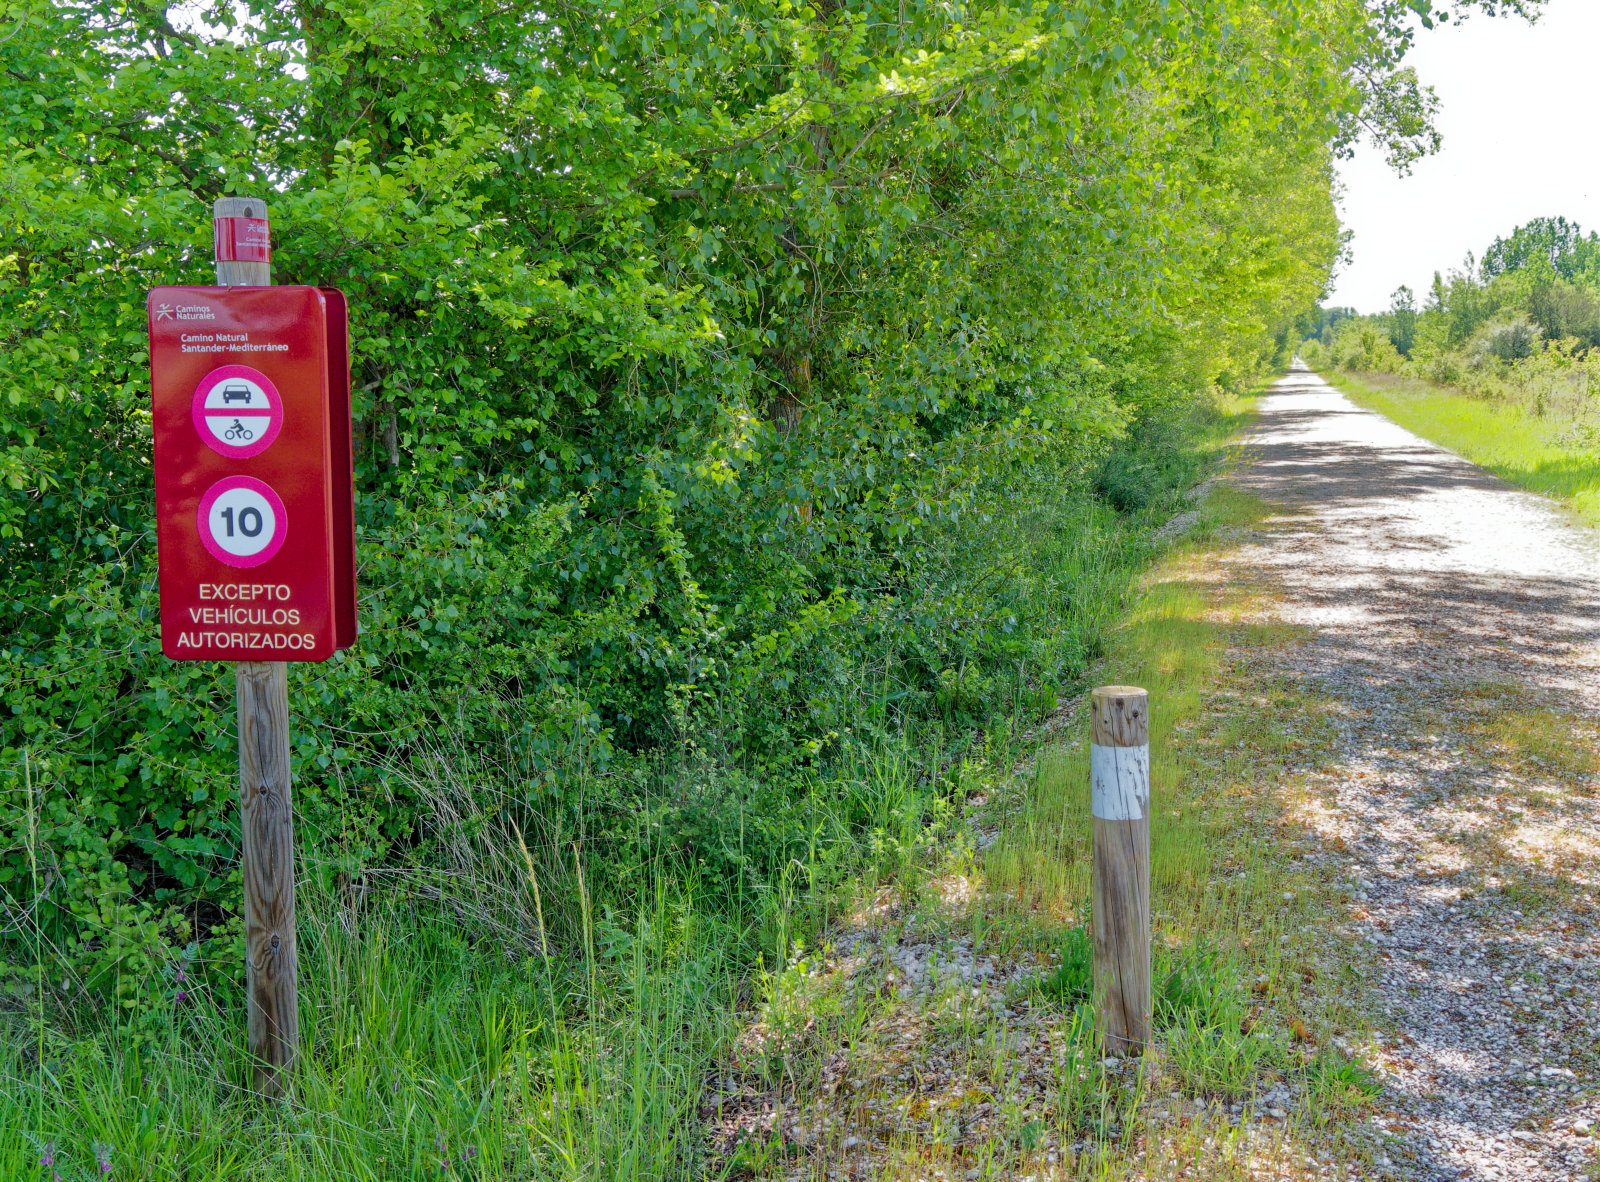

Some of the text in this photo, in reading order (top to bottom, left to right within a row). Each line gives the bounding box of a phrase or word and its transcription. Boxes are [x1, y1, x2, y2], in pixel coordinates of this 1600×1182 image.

[176, 305, 210, 313] Caminos
[176, 312, 215, 320] Naturales
[181, 333, 248, 342] Camino Natural
[181, 343, 289, 352] Santander-Mediterráneo
[220, 506, 263, 537] 10
[199, 583, 291, 601] EXCEPTO
[189, 604, 300, 625] VEHÍCULOS
[177, 631, 316, 650] AUTORIZADOS
